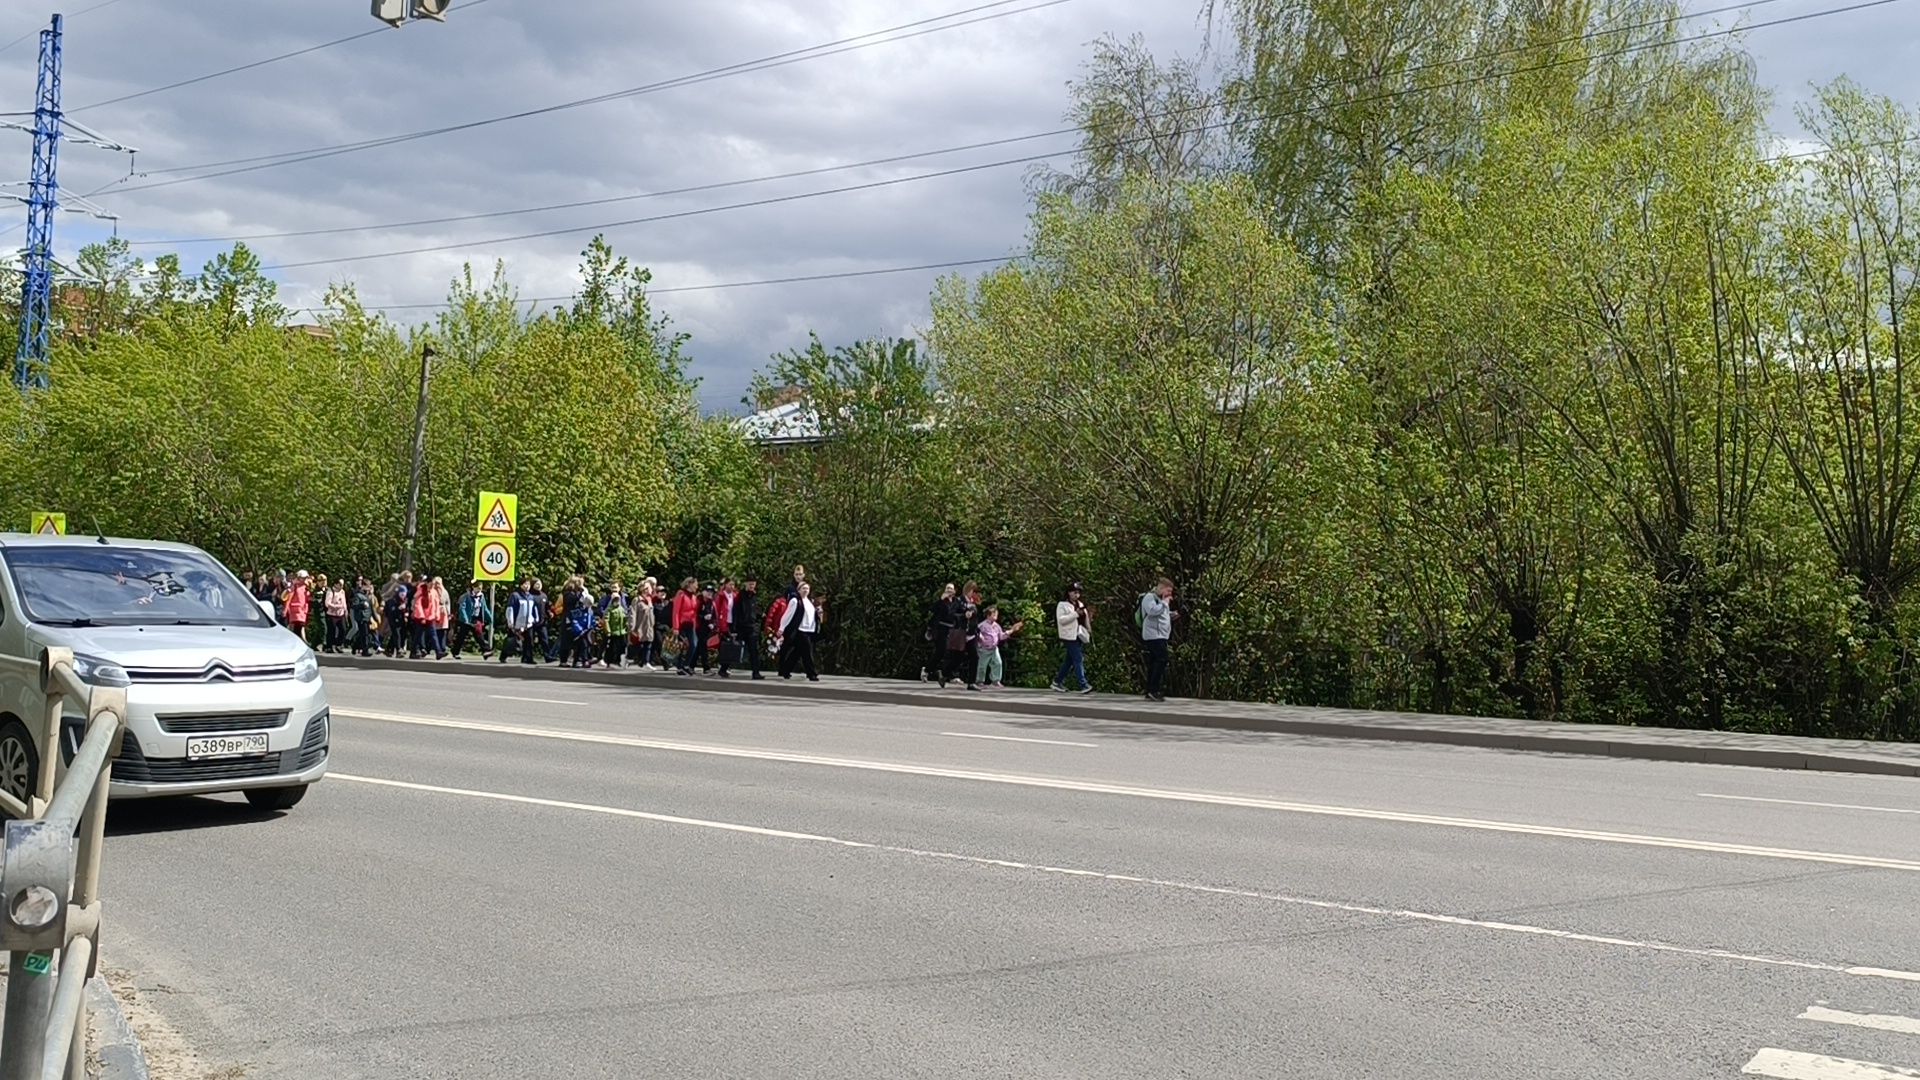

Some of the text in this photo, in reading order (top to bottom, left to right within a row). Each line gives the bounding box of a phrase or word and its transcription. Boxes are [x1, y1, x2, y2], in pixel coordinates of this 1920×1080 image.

[486, 552, 503, 564] 40
[192, 736, 264, 754] О389ВР 790
